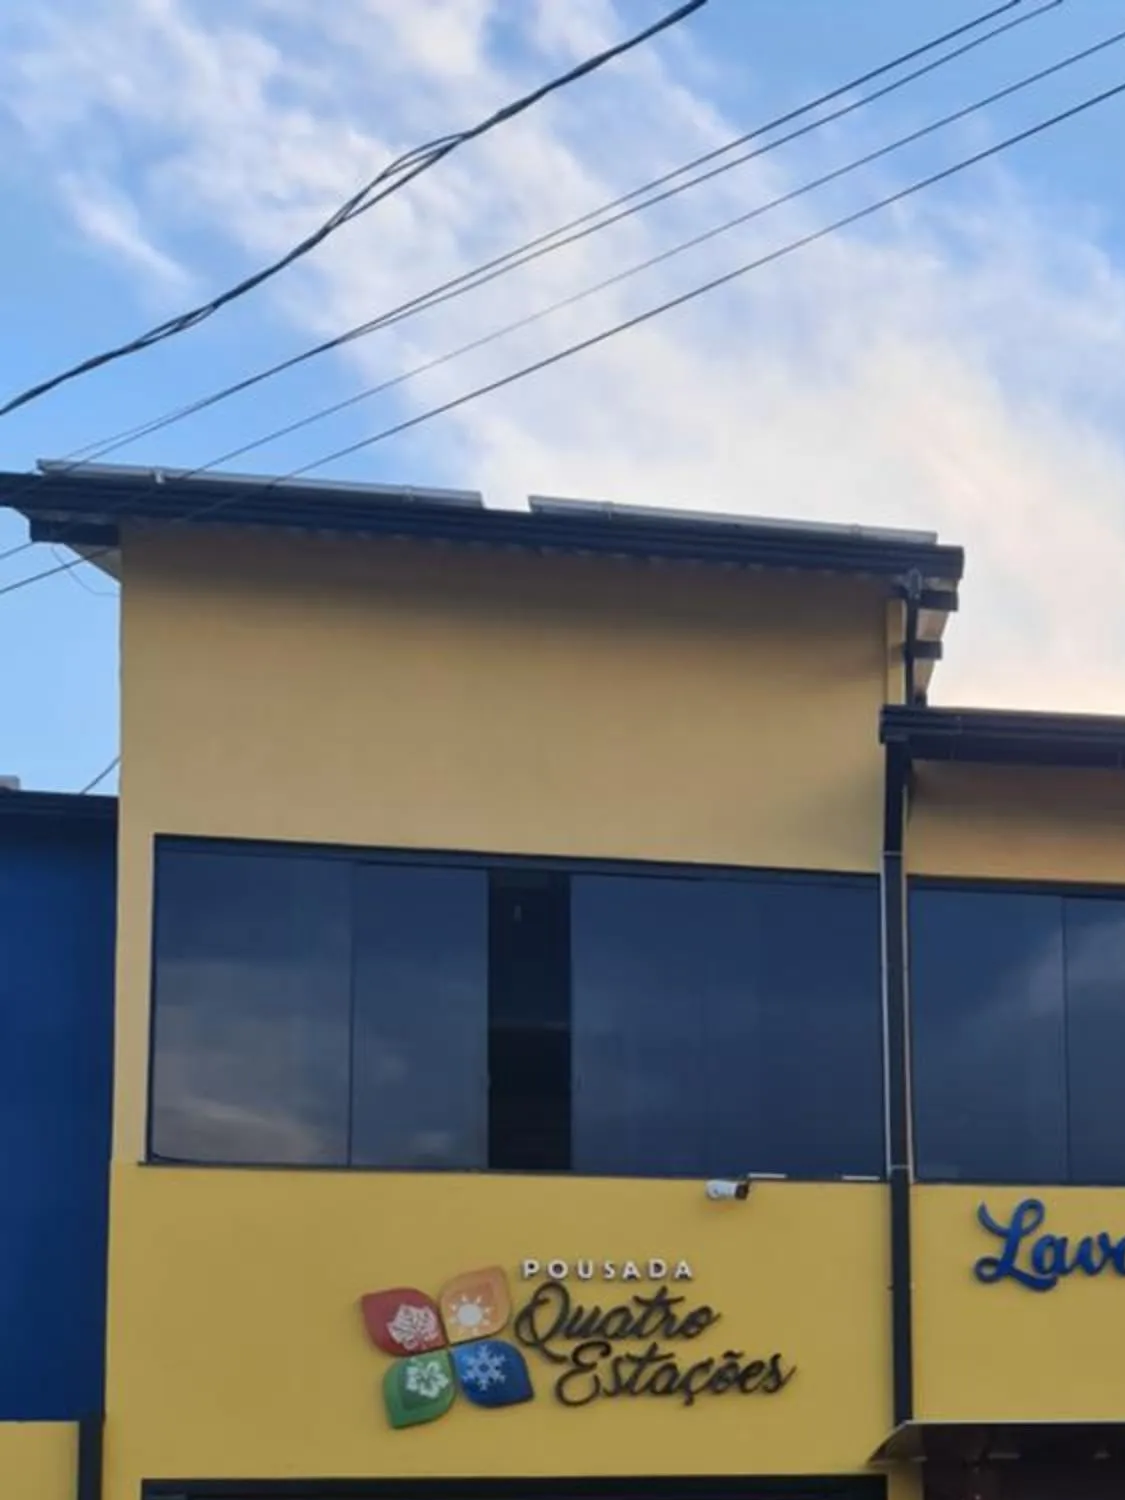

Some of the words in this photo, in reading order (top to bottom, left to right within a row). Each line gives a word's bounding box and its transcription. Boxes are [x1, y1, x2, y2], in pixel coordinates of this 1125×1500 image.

[522, 1259, 694, 1280] POUSADA
[515, 1282, 721, 1363] Quatro
[554, 1340, 797, 1407] Estações
